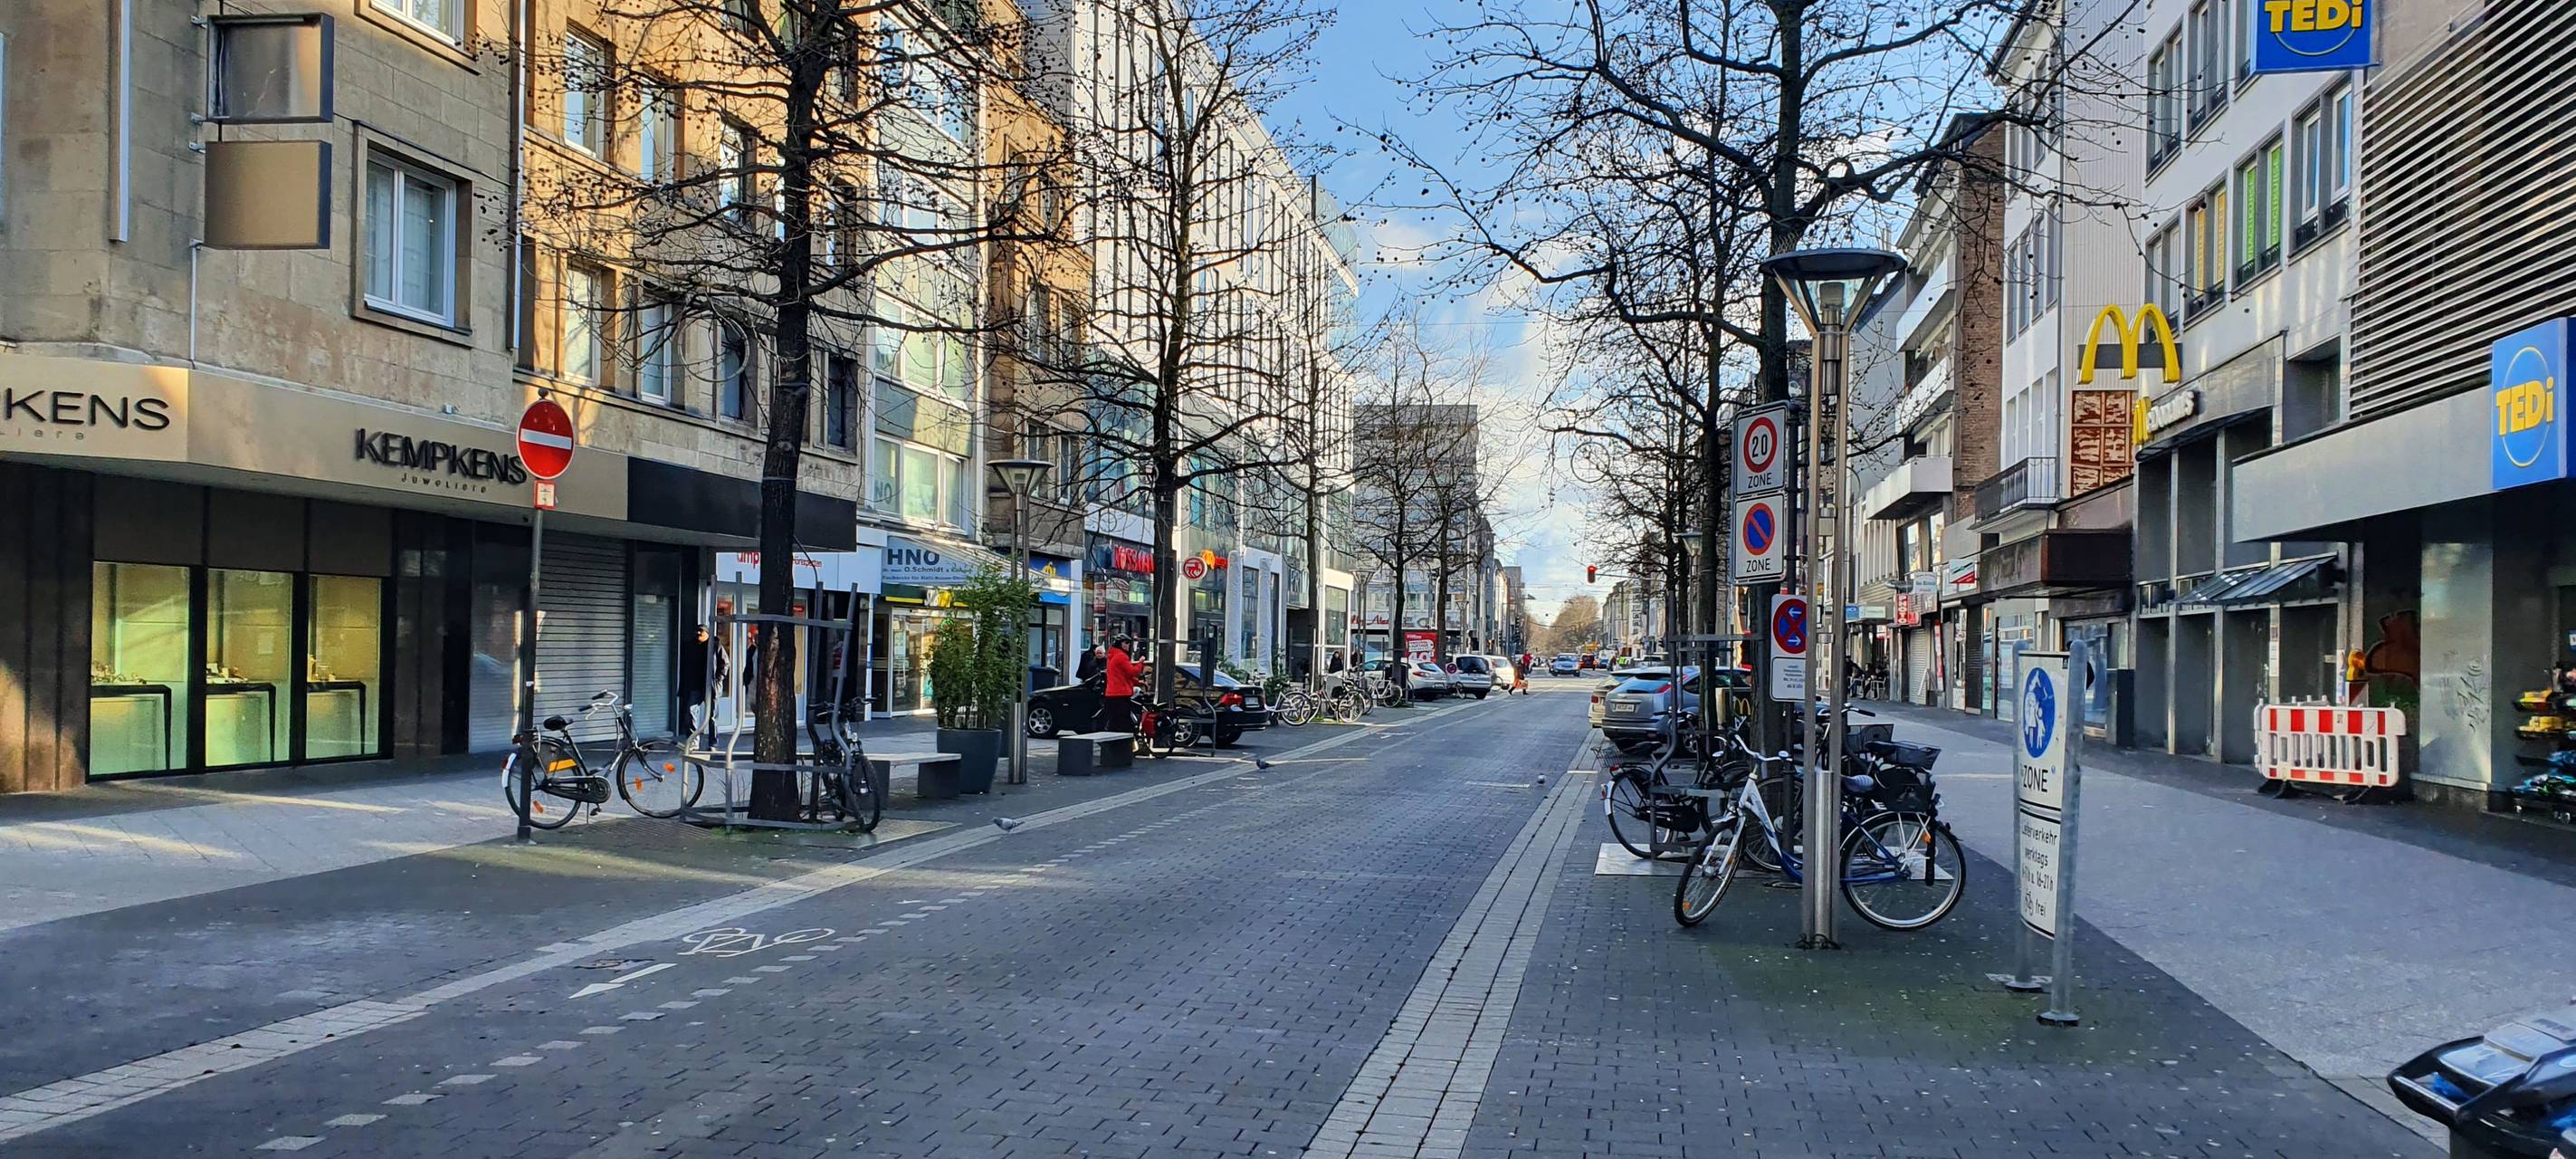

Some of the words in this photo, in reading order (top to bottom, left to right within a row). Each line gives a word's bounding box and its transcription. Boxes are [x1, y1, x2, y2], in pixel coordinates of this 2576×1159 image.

[2265, 0, 2362, 33] TEDi
[2495, 376, 2554, 436] TEDi
[355, 428, 527, 484] KEMPKENS
[1751, 434, 1769, 458] 20
[1747, 472, 1772, 489] ZONE
[887, 549, 940, 566] HNO
[1746, 558, 1771, 573] ZONE
[2023, 764, 2048, 793] ZONE
[2036, 898, 2046, 918] frei
